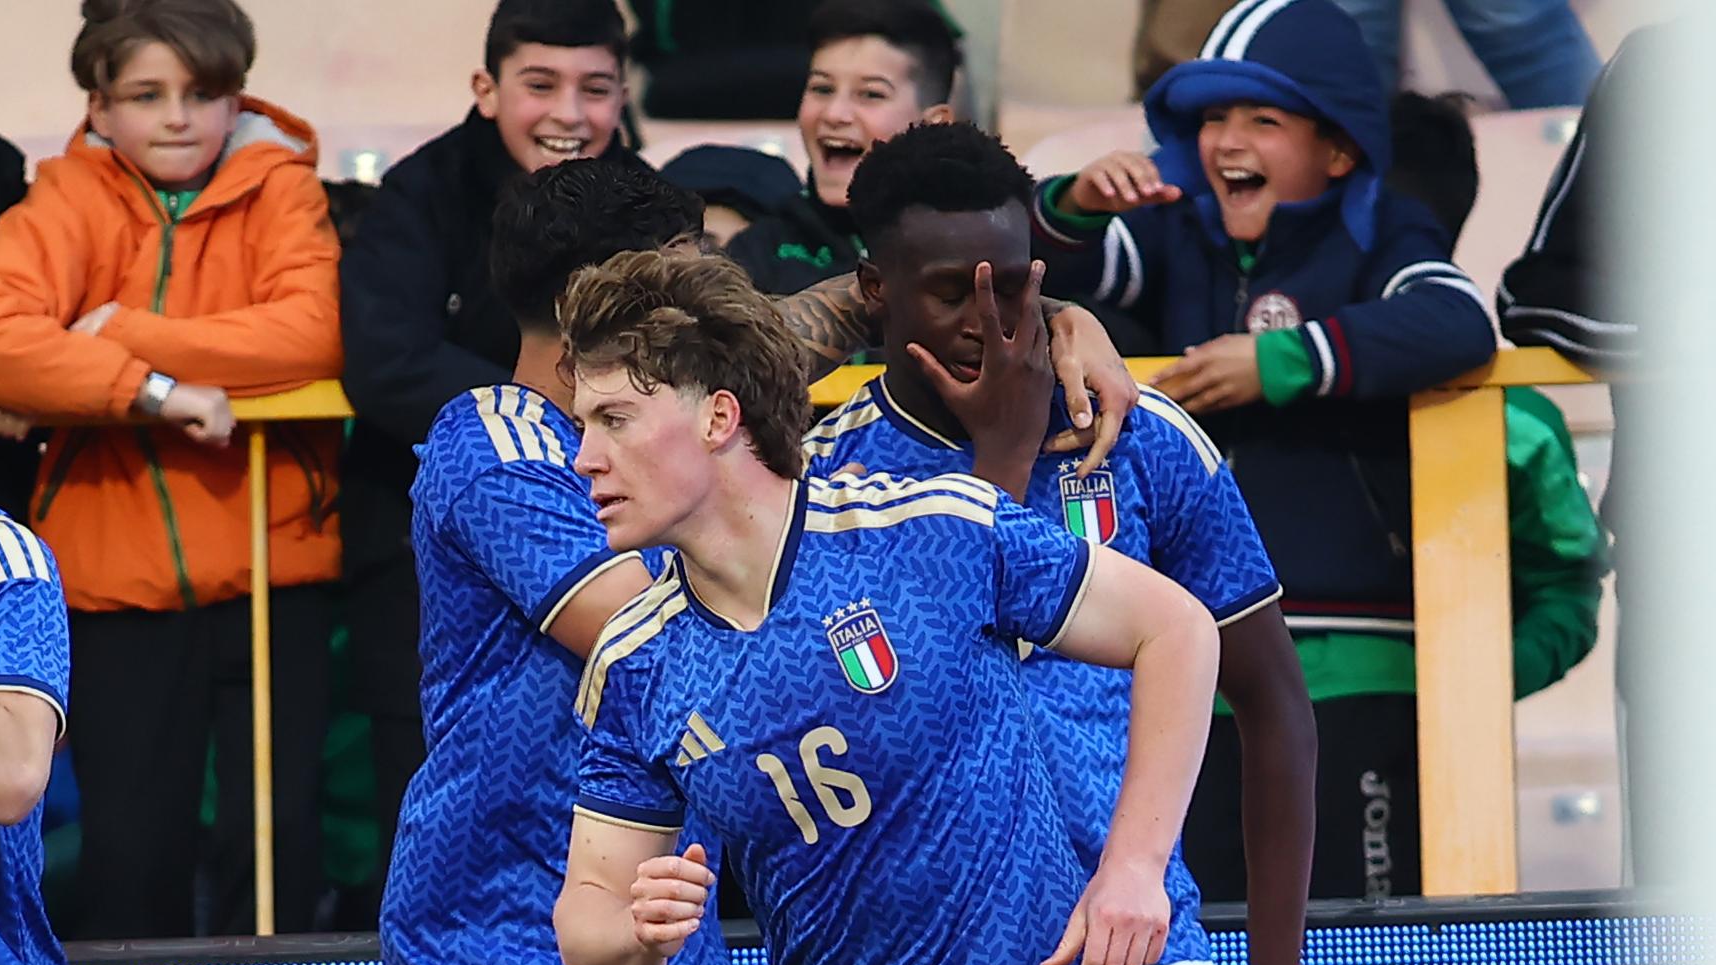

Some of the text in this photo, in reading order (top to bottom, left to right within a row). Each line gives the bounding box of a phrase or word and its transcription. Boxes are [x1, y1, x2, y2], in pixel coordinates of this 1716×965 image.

[1063, 478, 1110, 495] ITALIA
[832, 617, 878, 647] ITALIA
[756, 725, 872, 845] 16
